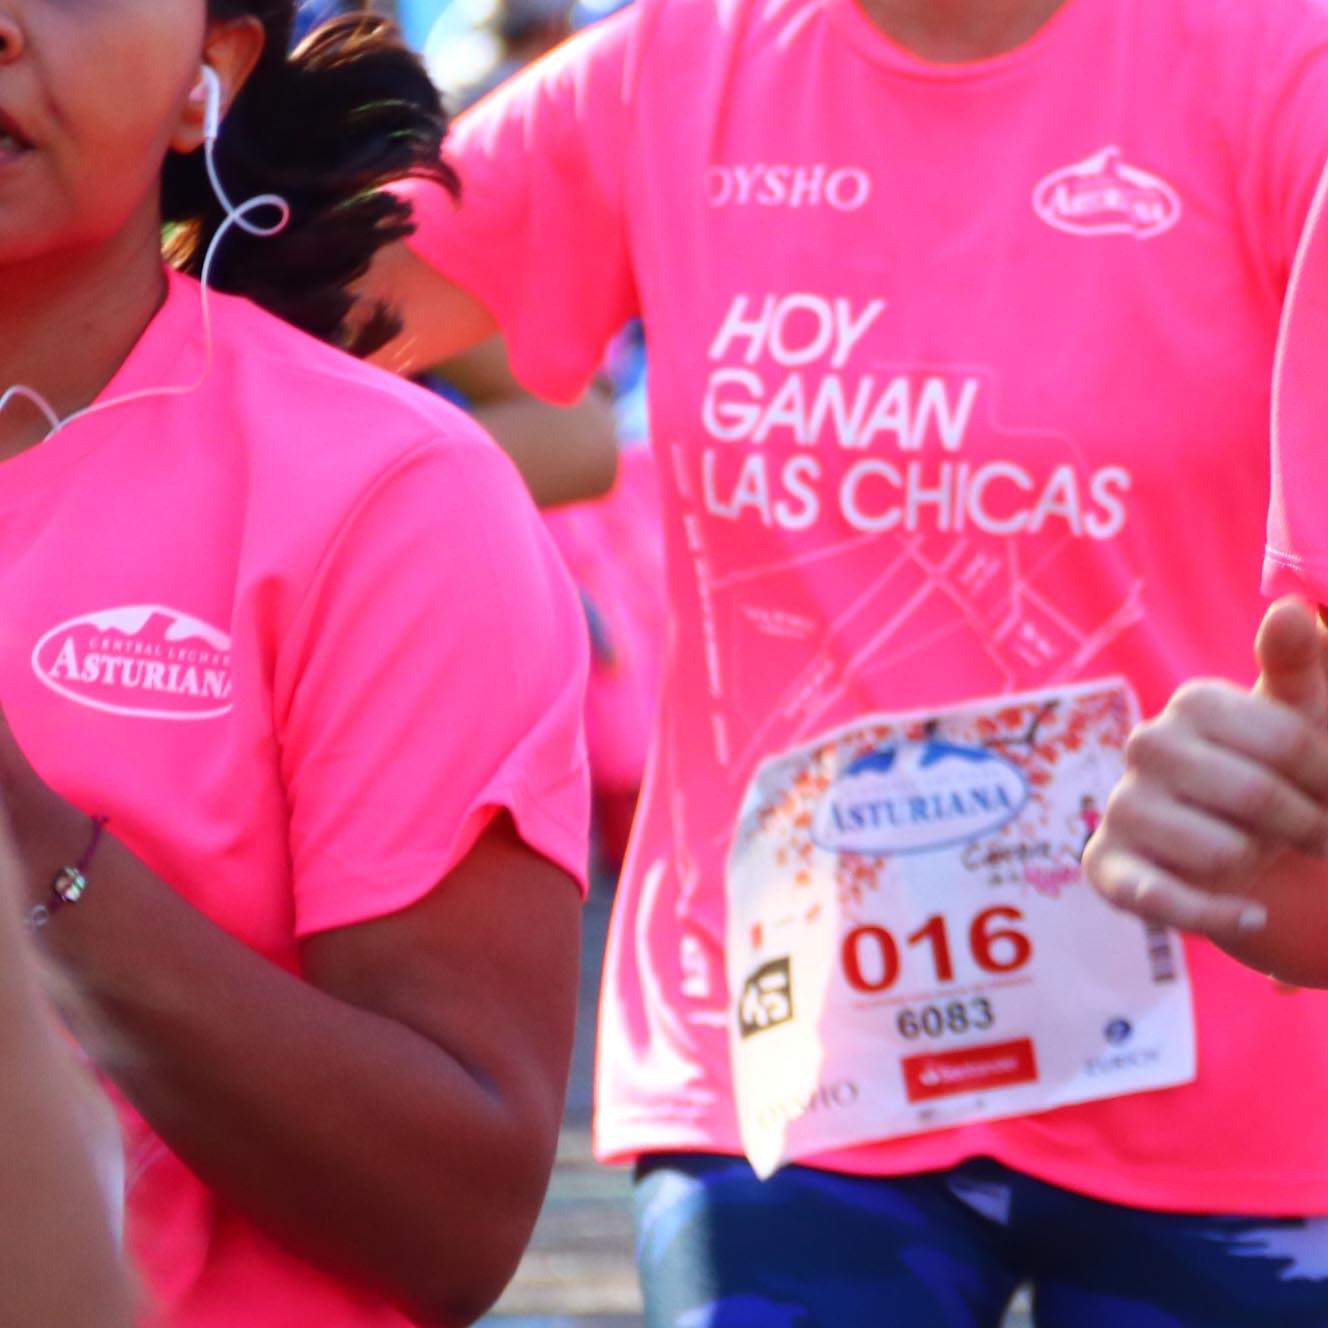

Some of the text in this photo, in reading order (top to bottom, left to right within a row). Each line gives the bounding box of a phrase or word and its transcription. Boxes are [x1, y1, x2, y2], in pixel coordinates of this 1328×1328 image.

[708, 293, 886, 369] HOY
[702, 368, 978, 452] GANAN
[703, 448, 1132, 540] LAS CHICAS
[840, 904, 1033, 995] 016
[897, 996, 995, 1040] 6083
